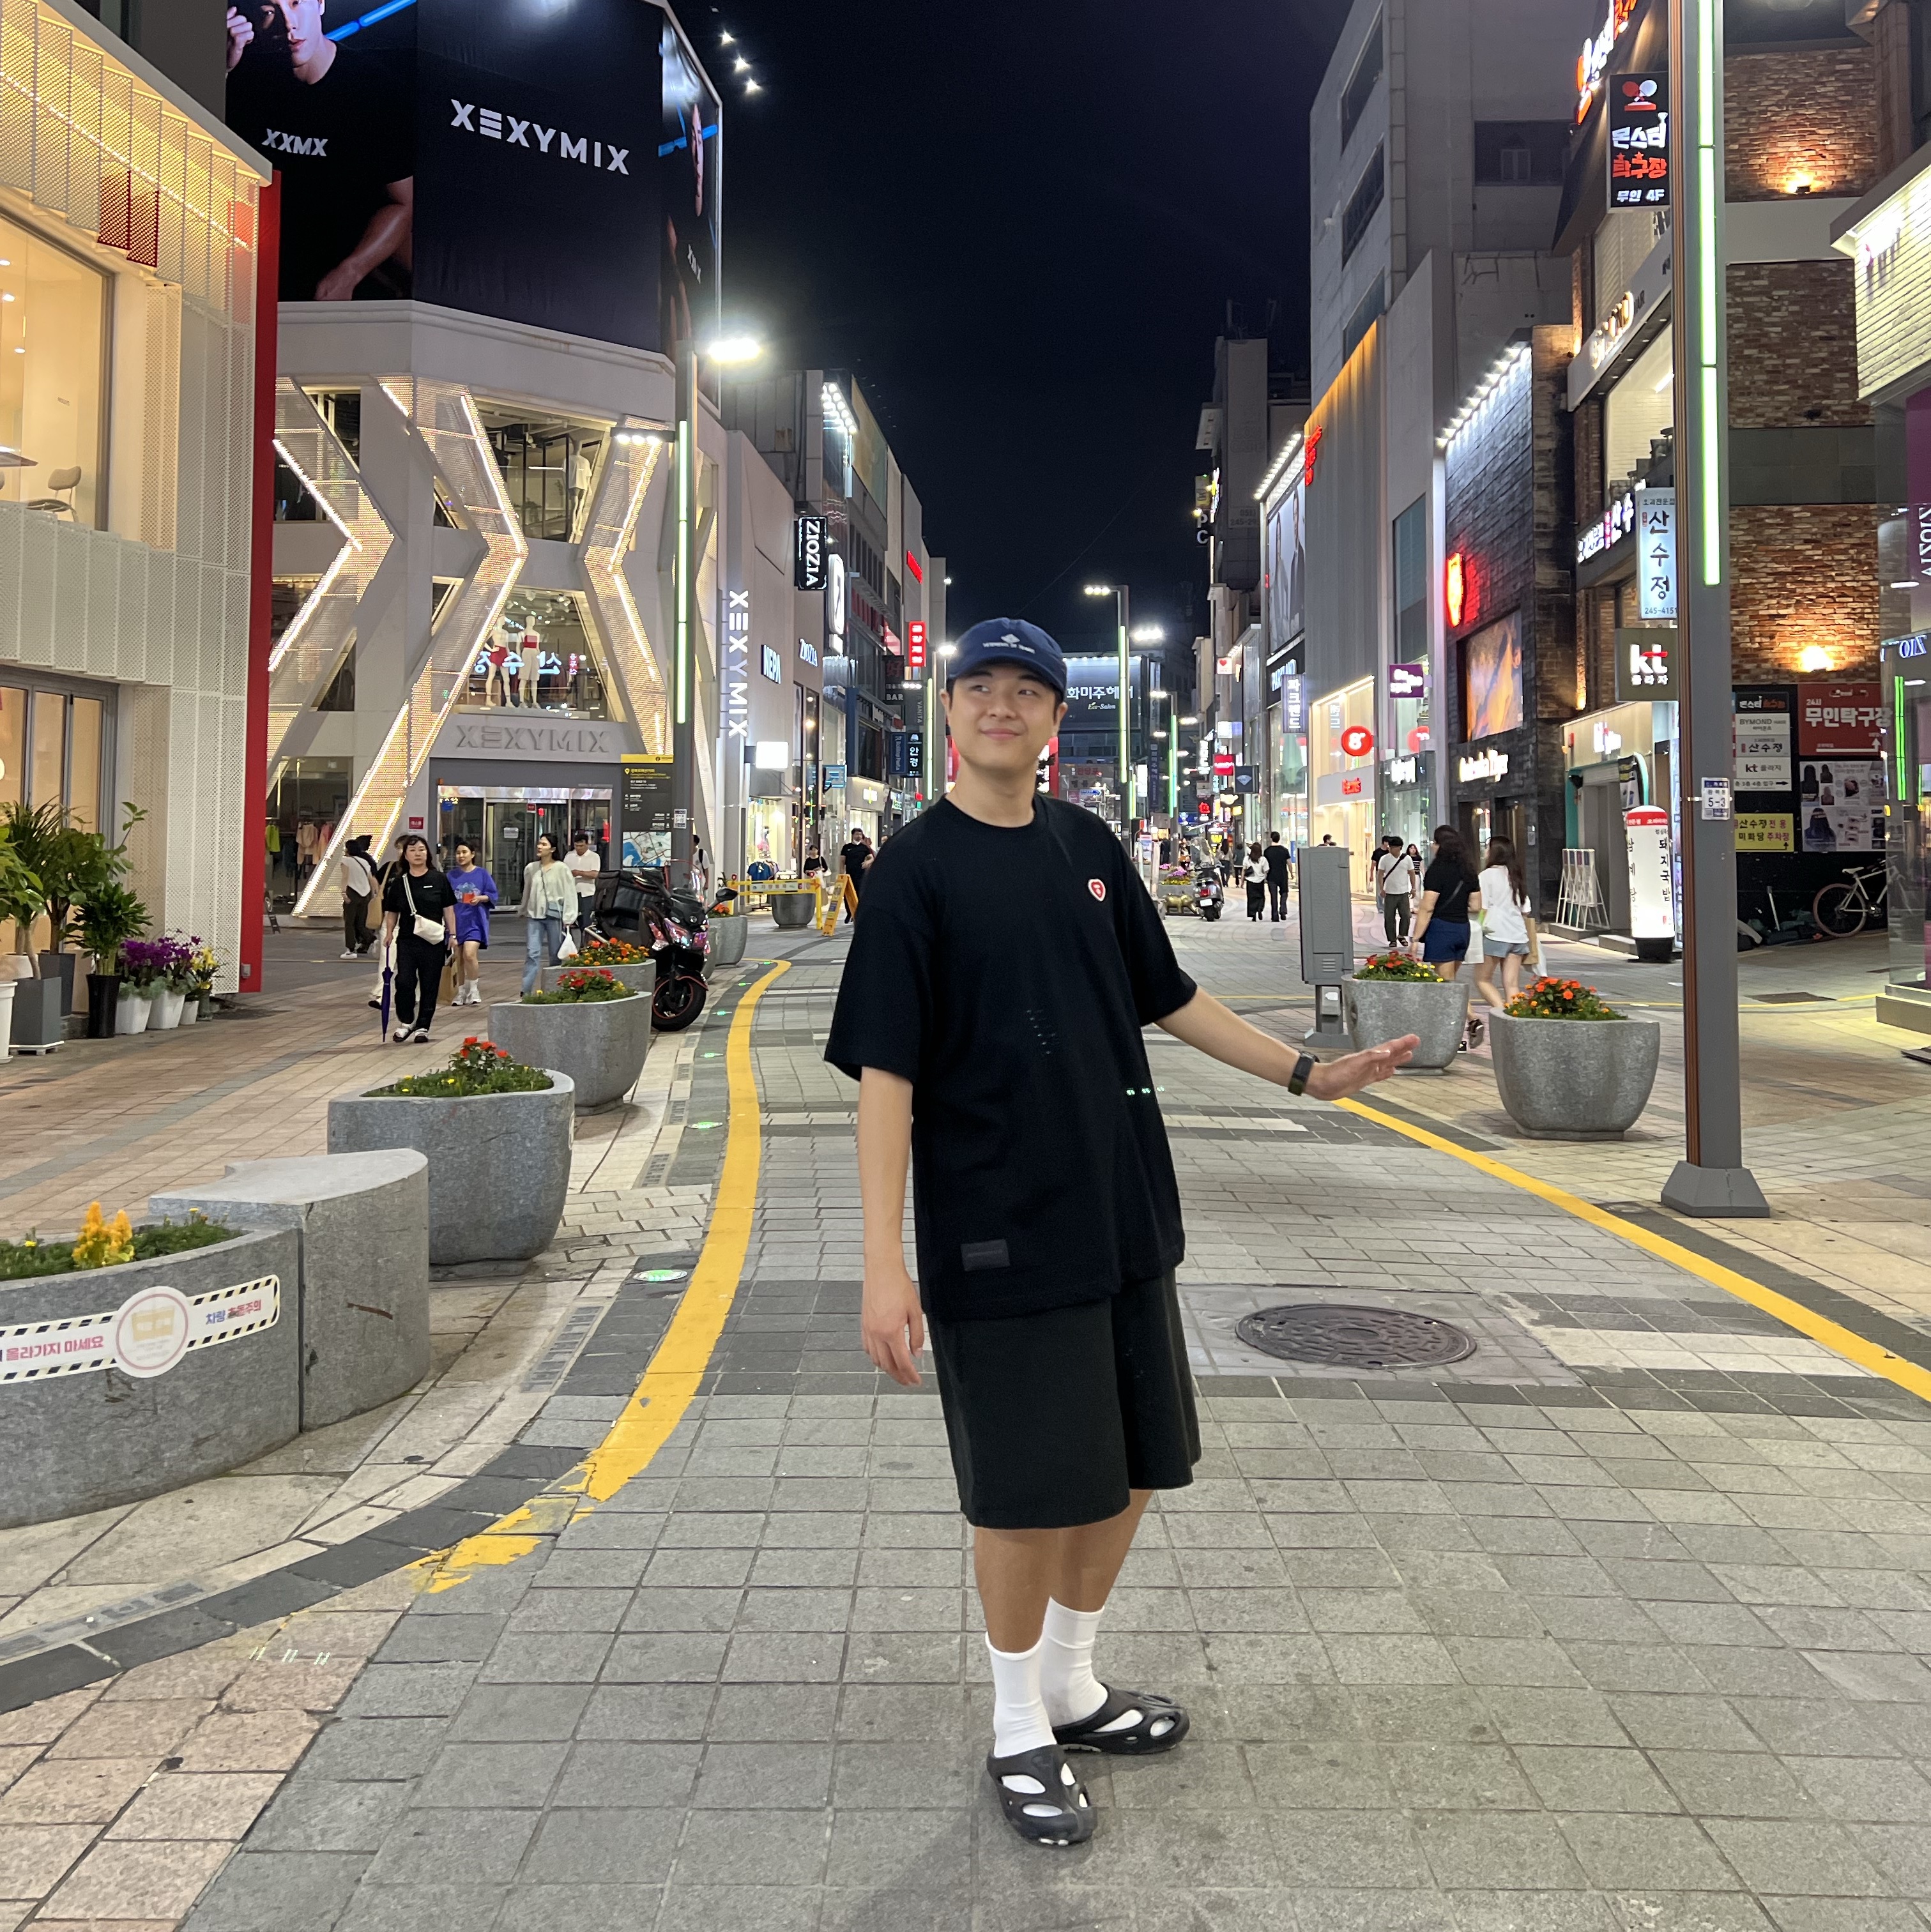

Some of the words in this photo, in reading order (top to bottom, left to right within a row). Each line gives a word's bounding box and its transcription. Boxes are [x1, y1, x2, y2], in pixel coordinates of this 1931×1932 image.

[261, 128, 328, 157] XXMX
[450, 98, 630, 175] XEXYMIX
[1612, 112, 1668, 149] 몬스터
[1613, 151, 1667, 179] 탁구장
[1617, 190, 1642, 202] 무인
[1646, 189, 1665, 201] 4F
[806, 521, 820, 586] ZIOZIA
[1649, 510, 1670, 600] 산수정
[728, 590, 749, 738] XEXYMIX
[763, 644, 781, 684] NEPA
[800, 638, 818, 667] ZIOZIA
[1630, 644, 1668, 674] kt
[1805, 708, 1893, 727] 무인탁구장
[455, 725, 609, 753] XEXYMIX
[1748, 743, 1783, 753] 산수정
[909, 747, 919, 767] 안경
[1745, 764, 1758, 773] kt
[1708, 797, 1726, 807] 5-3
[1739, 819, 1767, 829] 산수정
[1739, 832, 1764, 842] 미화당
[1767, 832, 1790, 842] 주차장
[1659, 837, 1671, 902] 돼지국밥
[206, 1309, 226, 1325] 차량
[6, 1342, 61, 1361] 올라가지
[64, 1335, 105, 1353] 마세요
